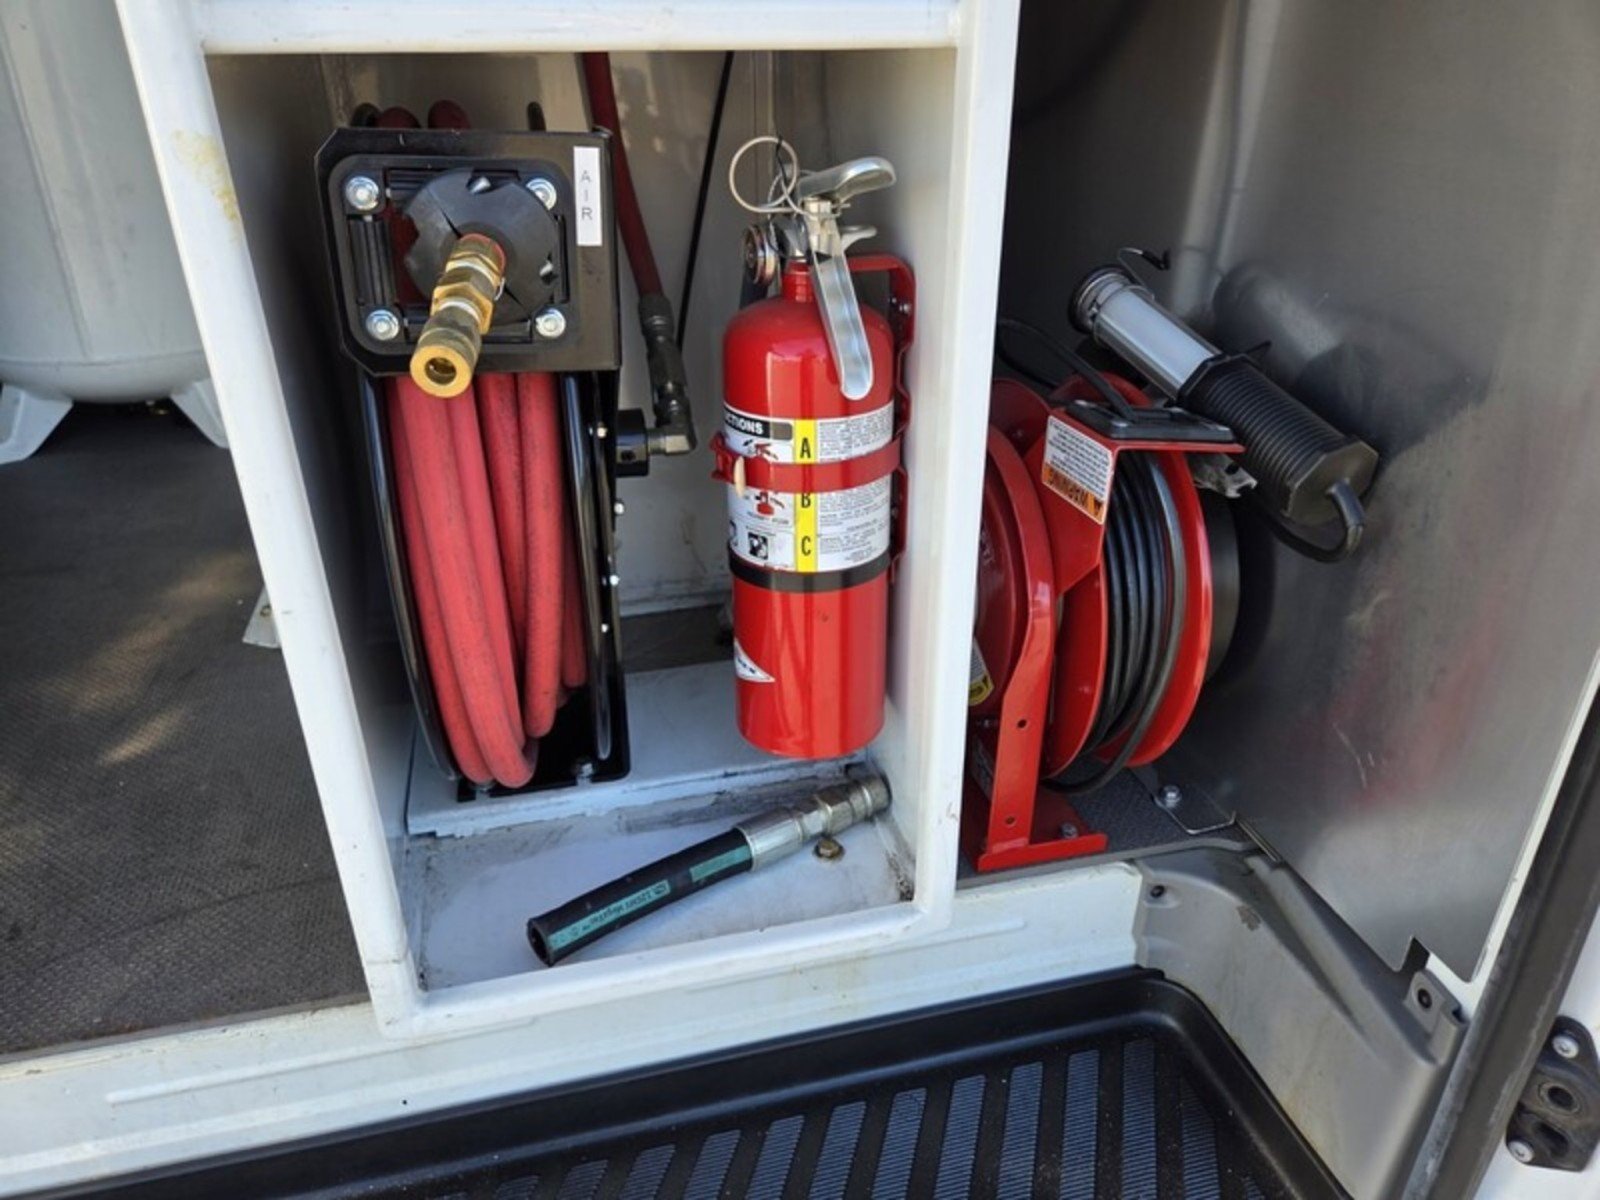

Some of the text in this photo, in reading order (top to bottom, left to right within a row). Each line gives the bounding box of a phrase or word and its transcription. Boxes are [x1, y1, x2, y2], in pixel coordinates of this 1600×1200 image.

[580, 170, 593, 221] AIR
[800, 437, 811, 458] A
[801, 492, 811, 508] B
[801, 535, 811, 556] C
